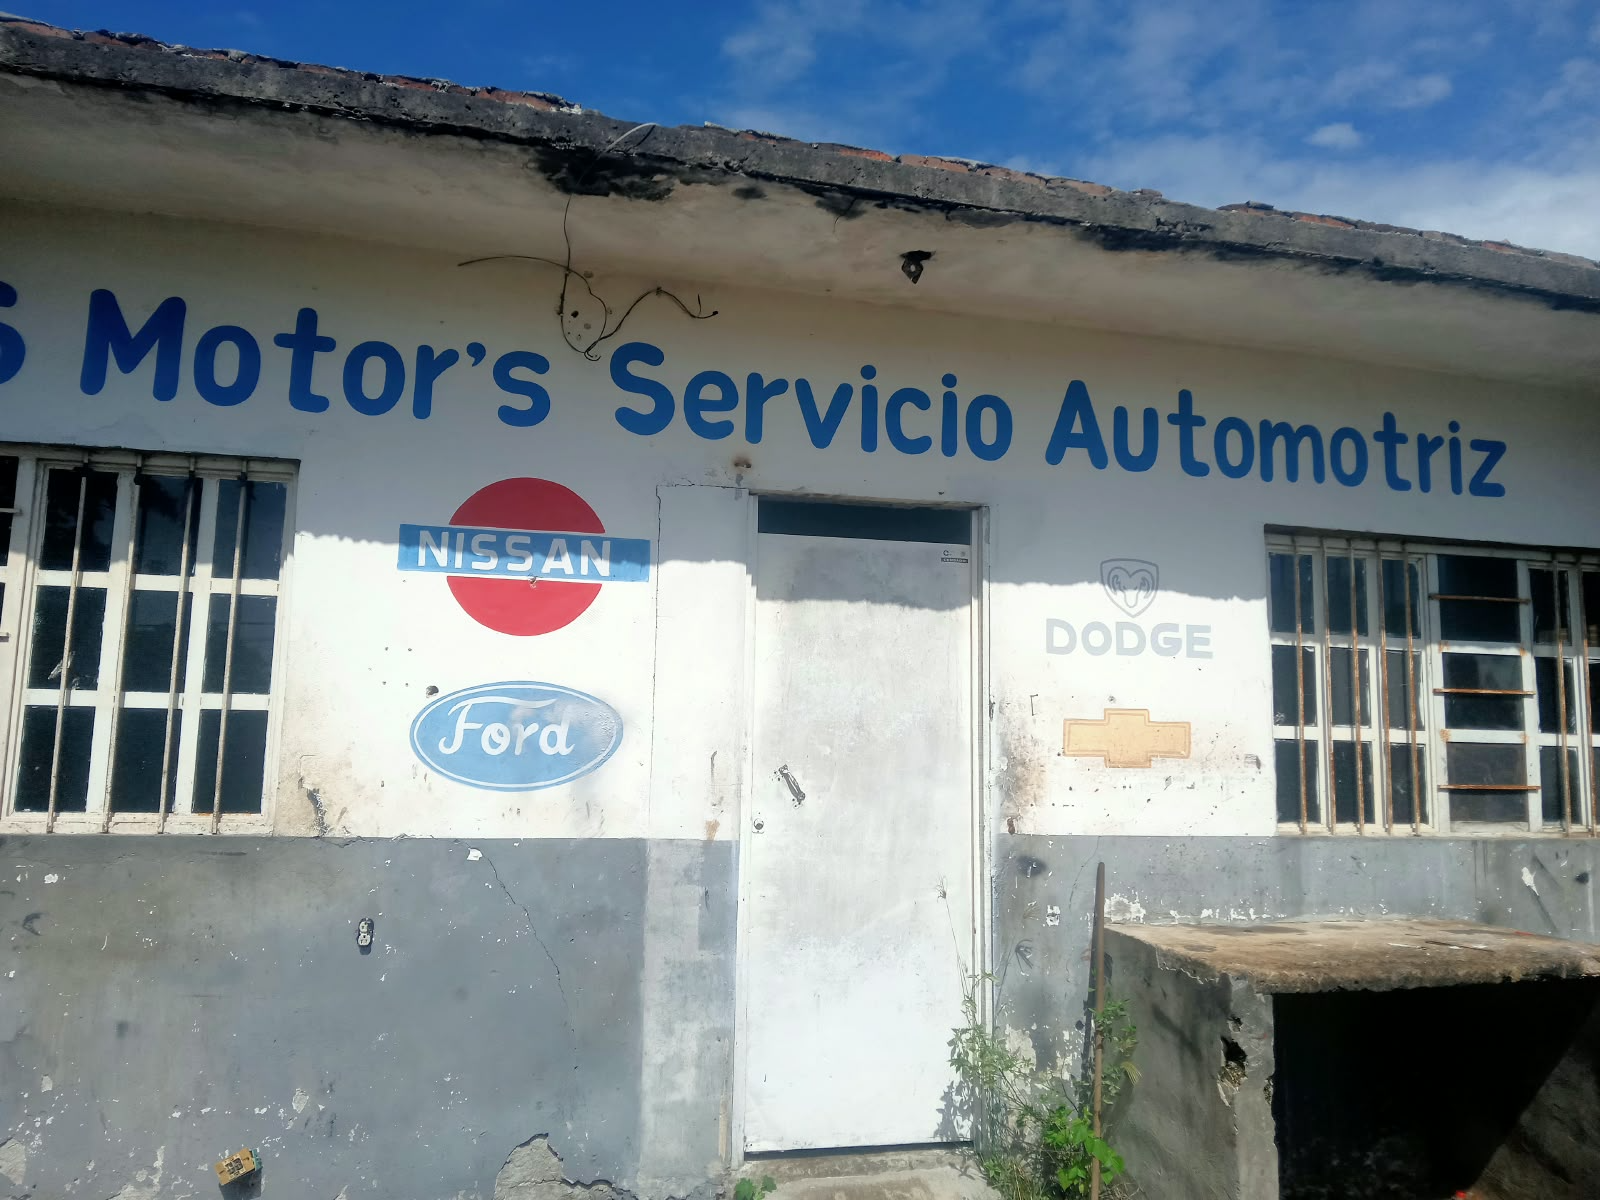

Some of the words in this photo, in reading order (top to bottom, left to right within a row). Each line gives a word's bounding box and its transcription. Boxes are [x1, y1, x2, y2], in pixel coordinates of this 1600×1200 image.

[80, 288, 551, 428] Motor's
[610, 341, 1013, 462] Servicio
[1045, 379, 1507, 498] Automotriz
[417, 529, 611, 577] NISSAN
[1045, 618, 1213, 660] DODGE
[438, 696, 576, 756] Ford
